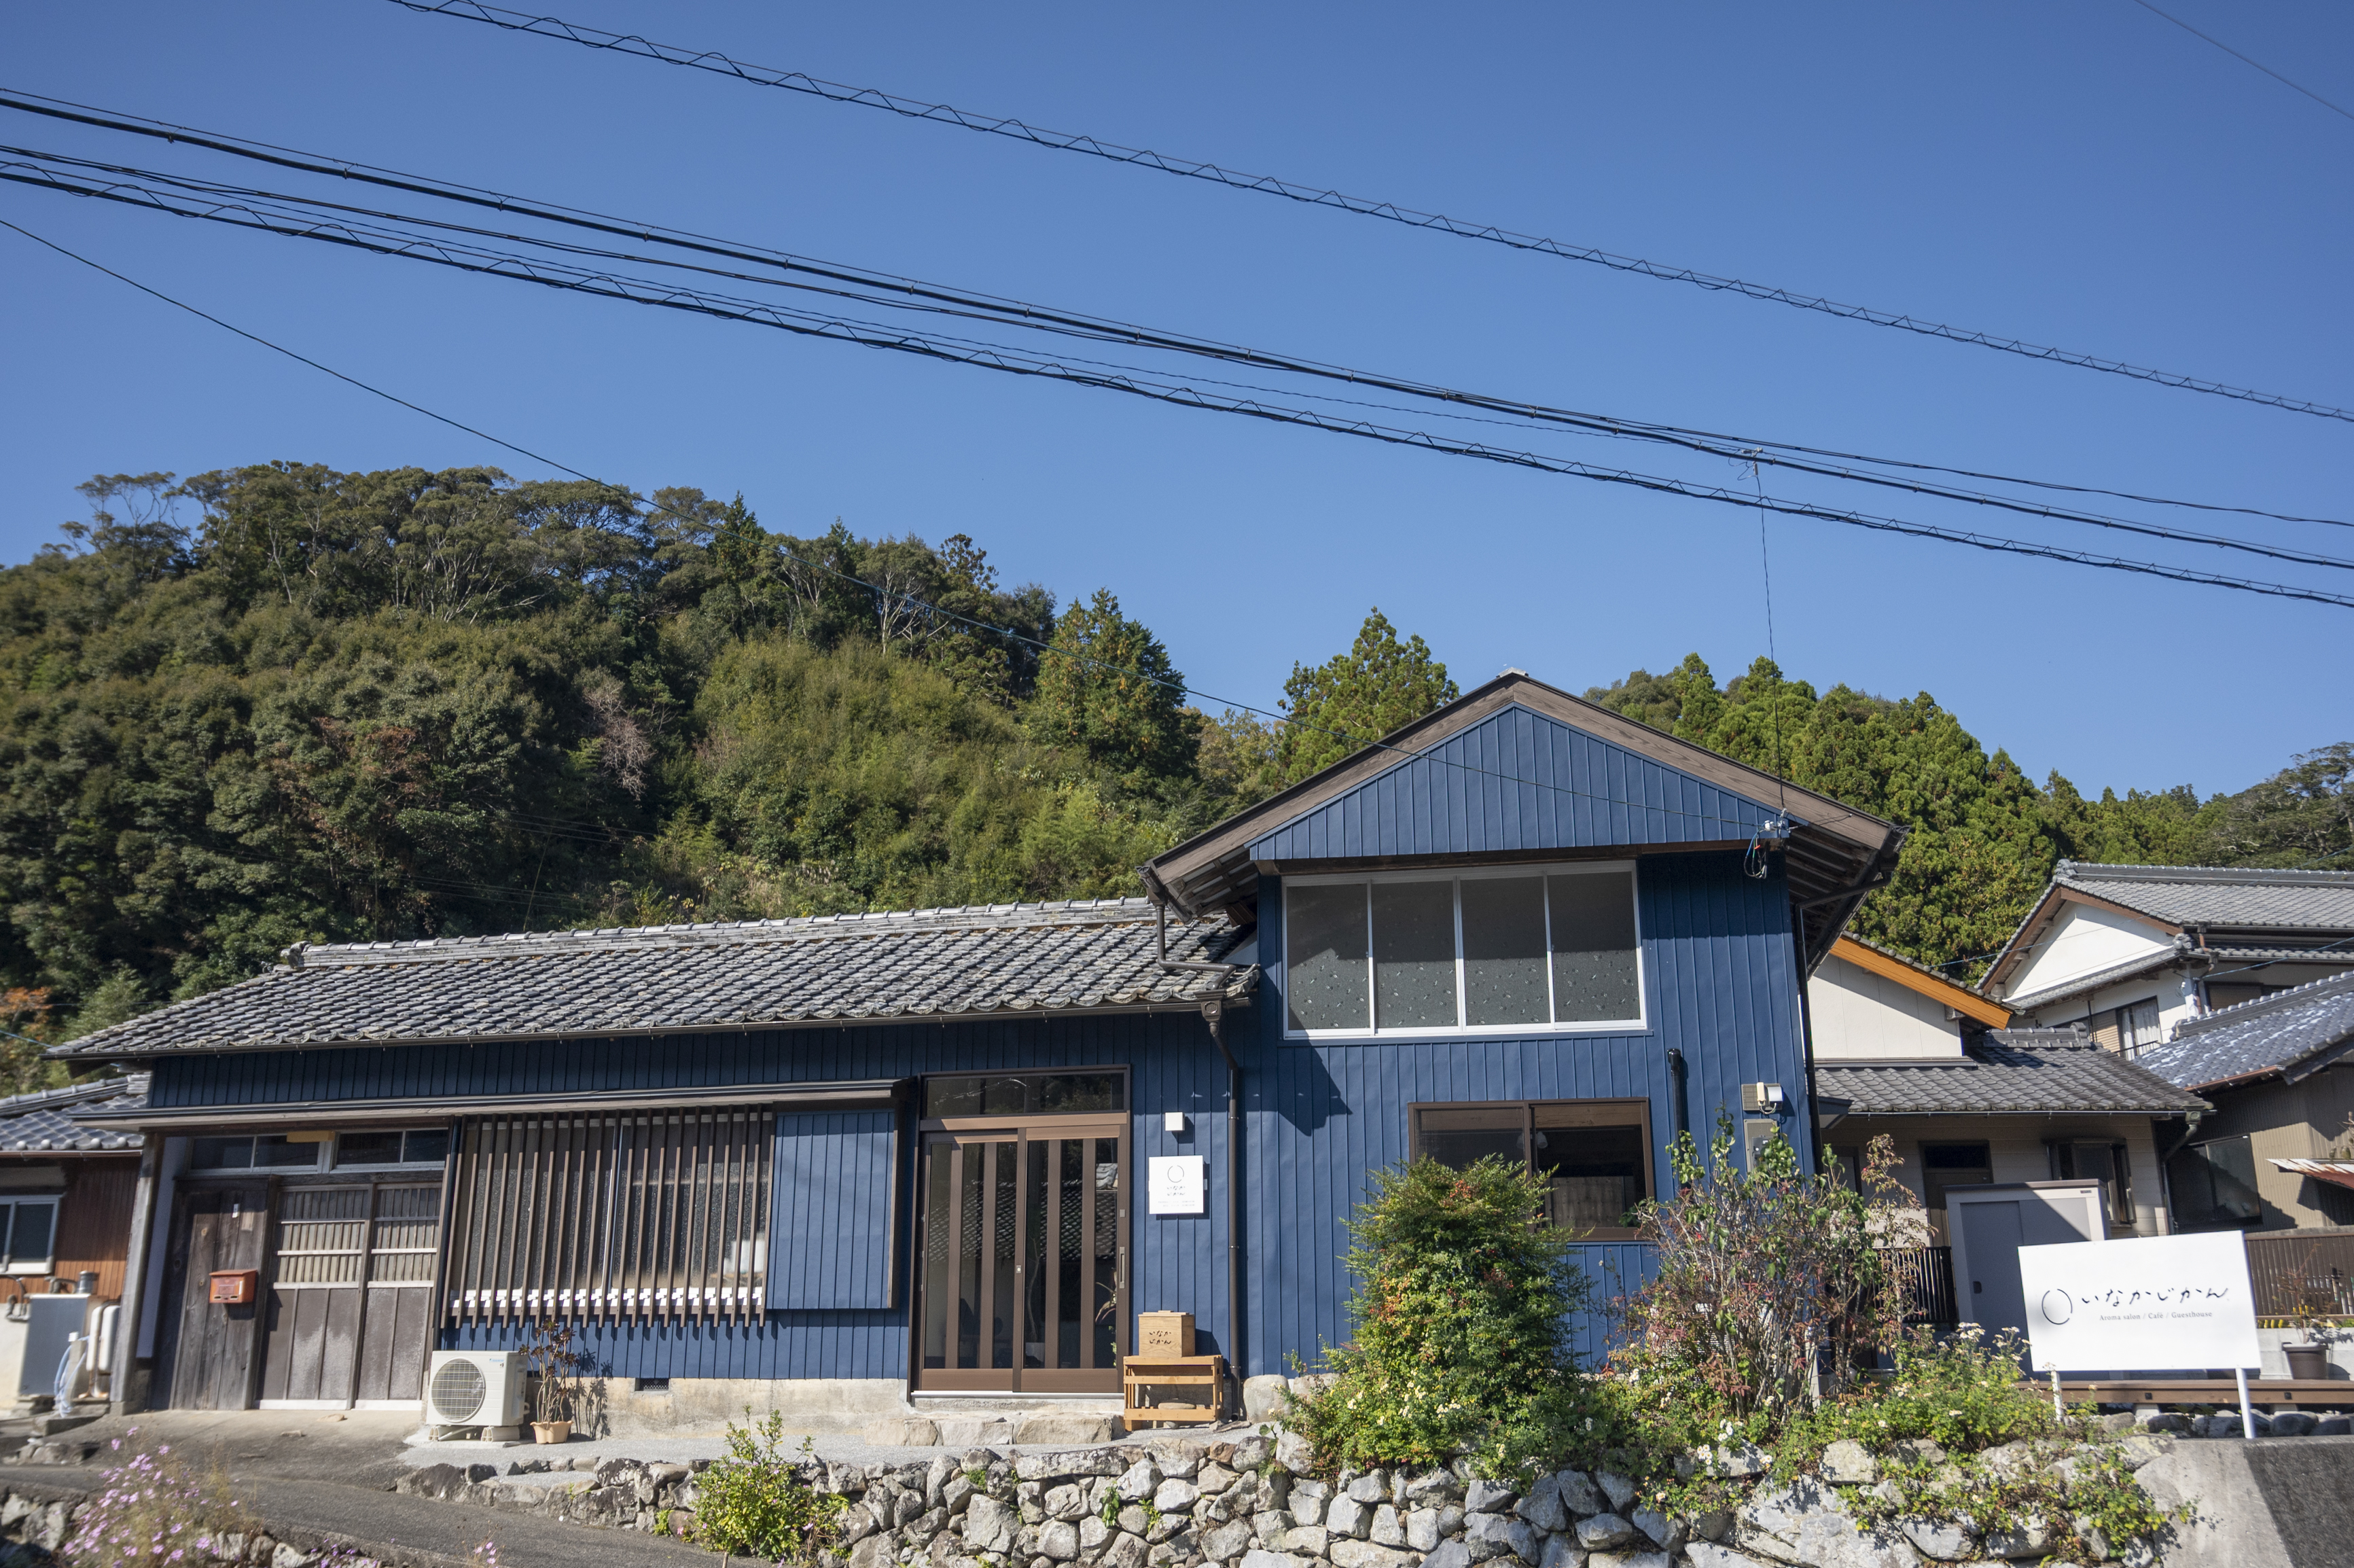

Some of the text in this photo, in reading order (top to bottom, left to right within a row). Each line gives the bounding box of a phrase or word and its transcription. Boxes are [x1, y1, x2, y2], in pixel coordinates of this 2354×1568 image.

[2082, 1287, 2228, 1306] いなかじかん
